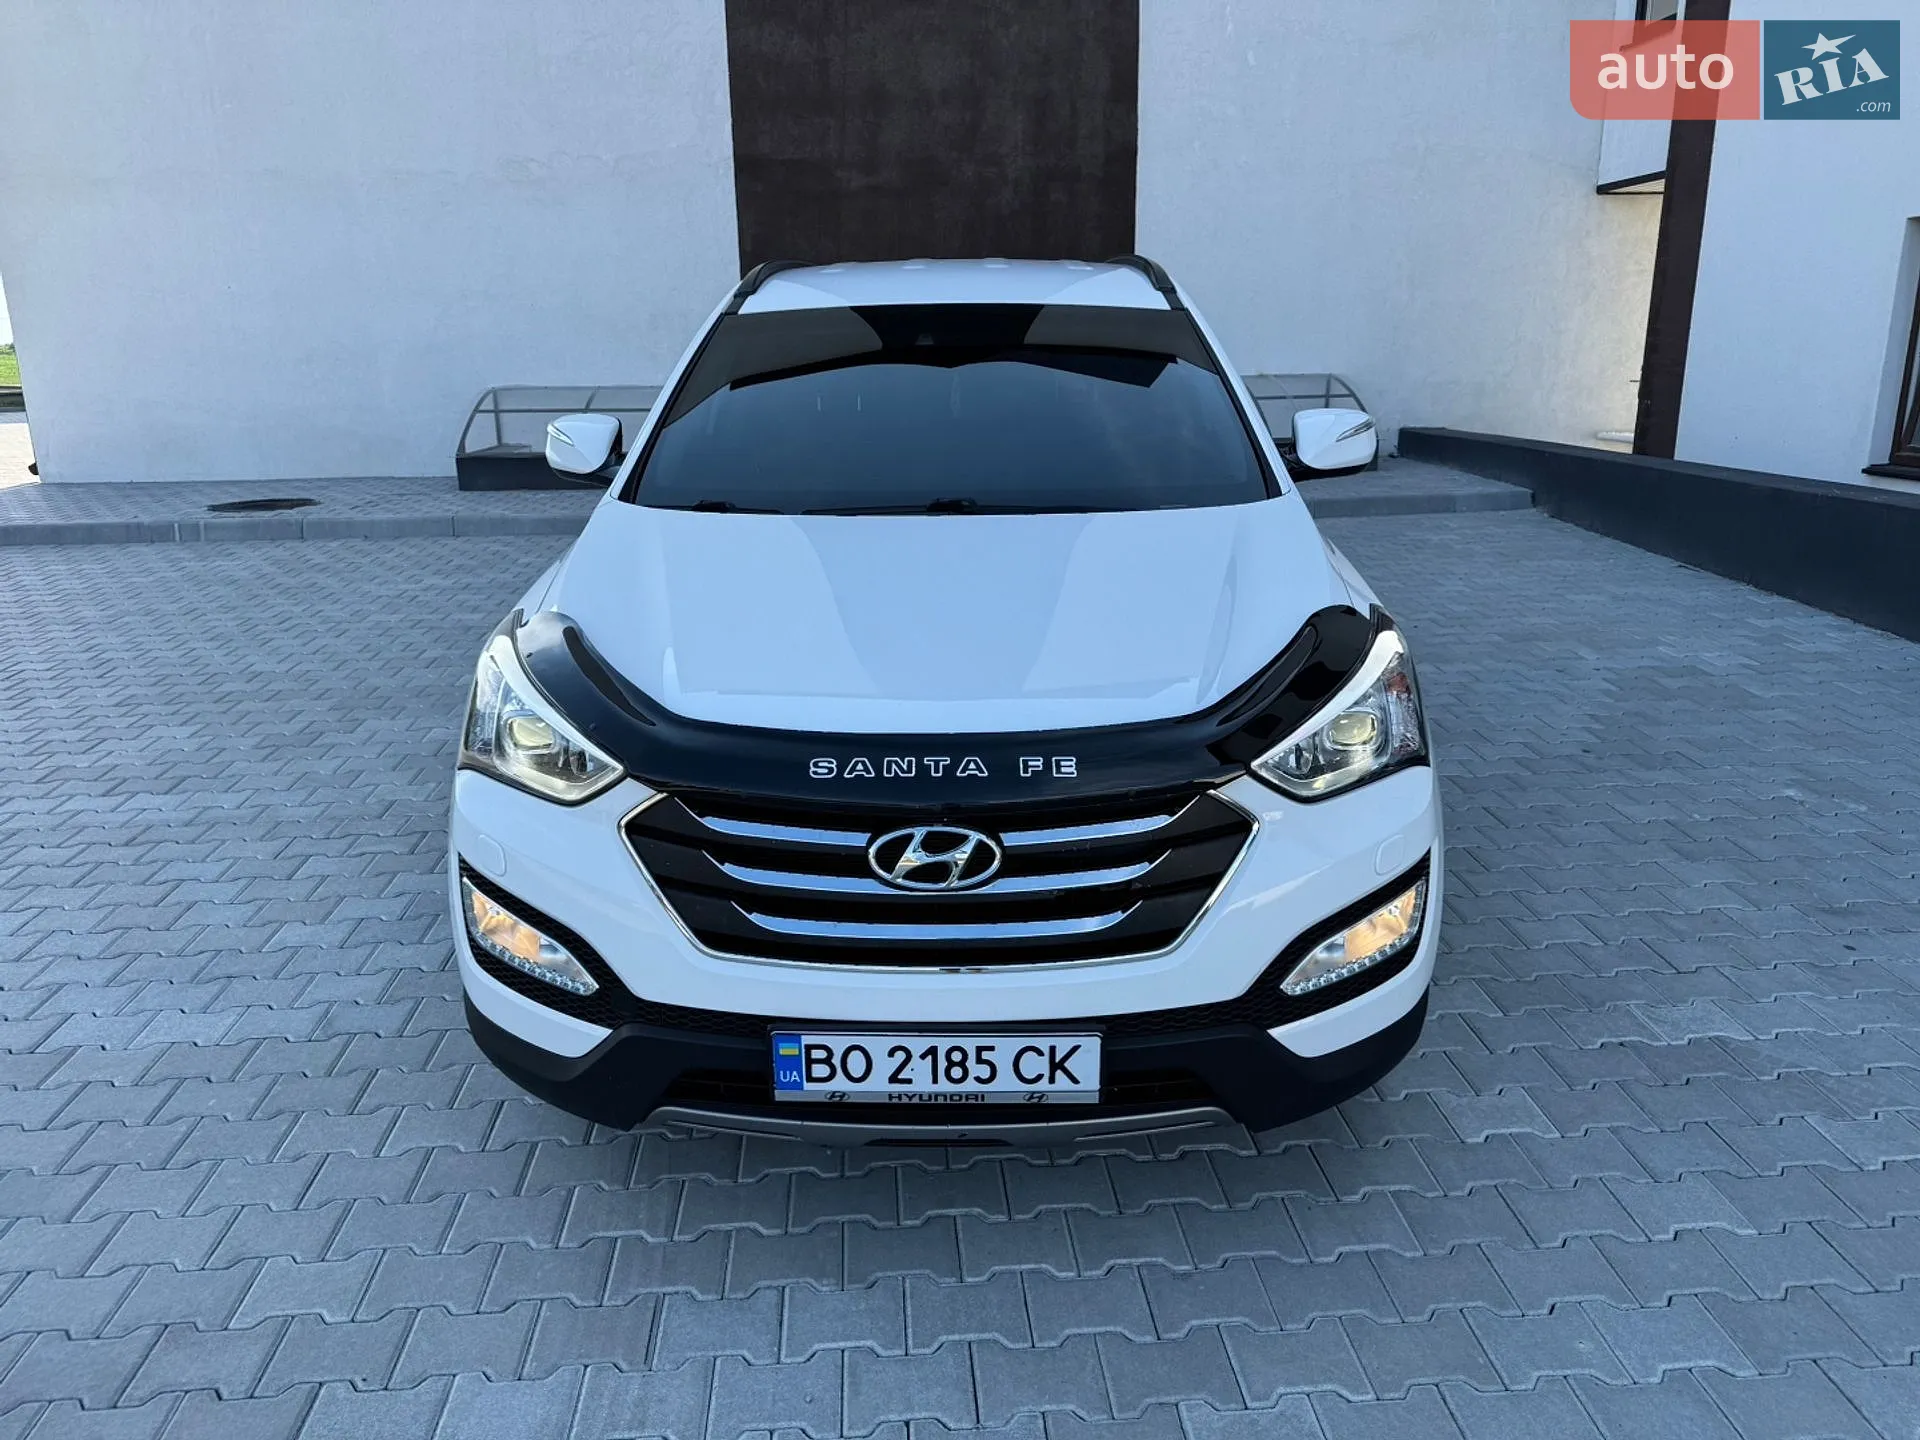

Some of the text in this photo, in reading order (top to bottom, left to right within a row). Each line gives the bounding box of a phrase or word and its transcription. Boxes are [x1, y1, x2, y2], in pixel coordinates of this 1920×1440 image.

[809, 757, 1077, 778] SANTA FE
[804, 1043, 1082, 1085] BO 2185 CK
[780, 1071, 801, 1083] UA
[888, 1093, 986, 1103] HYUNDAI
